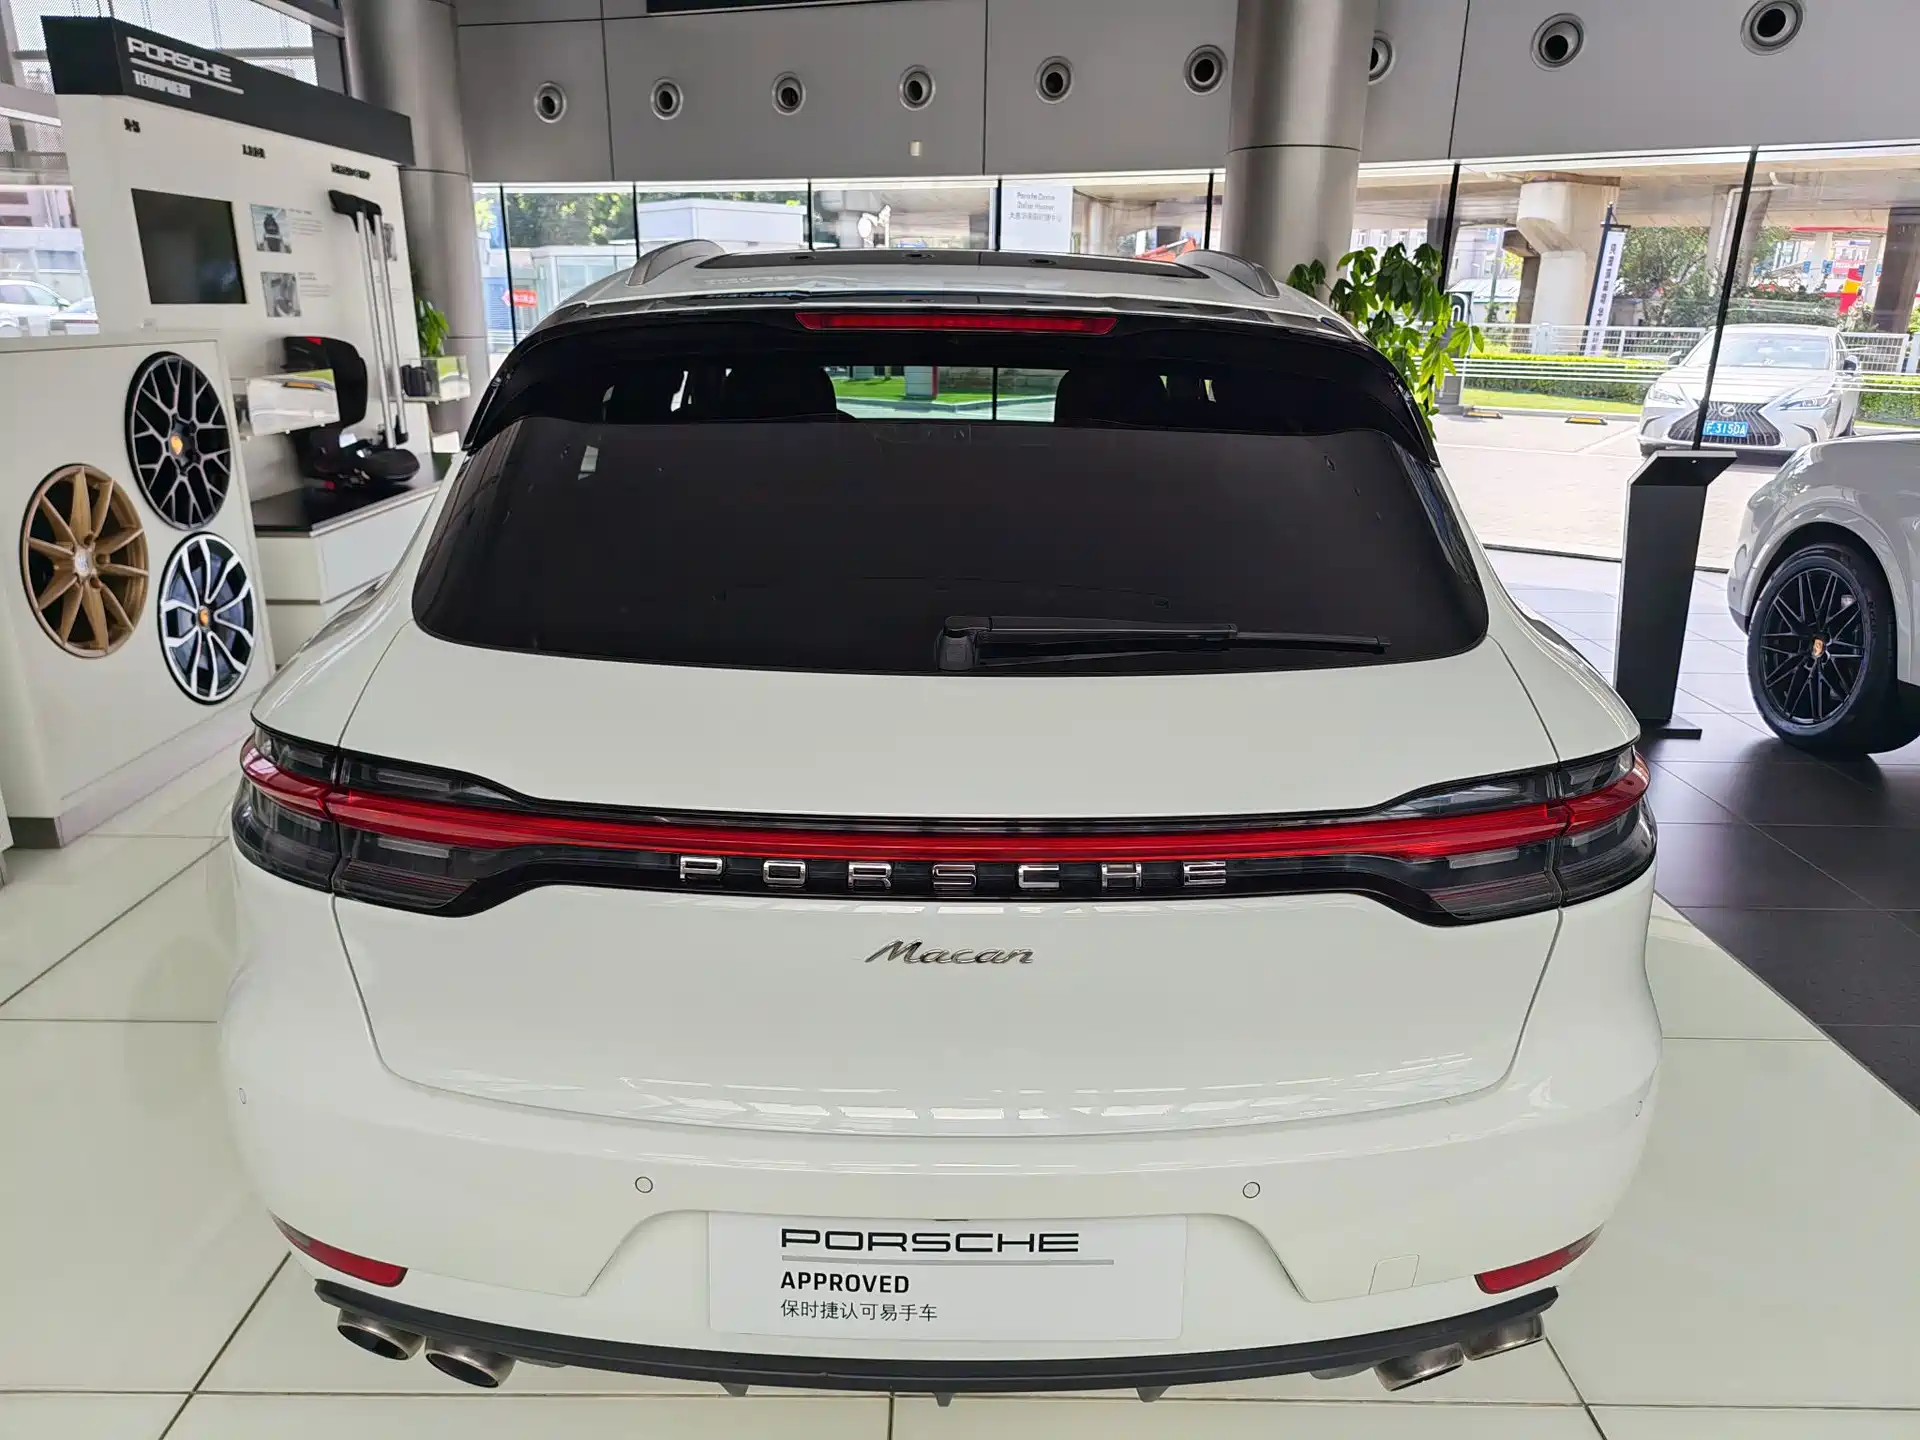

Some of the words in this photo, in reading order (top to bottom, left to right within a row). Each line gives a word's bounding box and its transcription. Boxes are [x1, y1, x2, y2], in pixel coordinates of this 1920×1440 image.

[126, 37, 232, 82] PORSCHE
[679, 855, 1227, 891] PORSCHE
[863, 938, 1034, 965] Macan
[781, 1228, 1079, 1253] PORSCHE
[780, 1271, 910, 1294] APPROVED
[780, 1299, 938, 1322] 保时捷认可易手车
